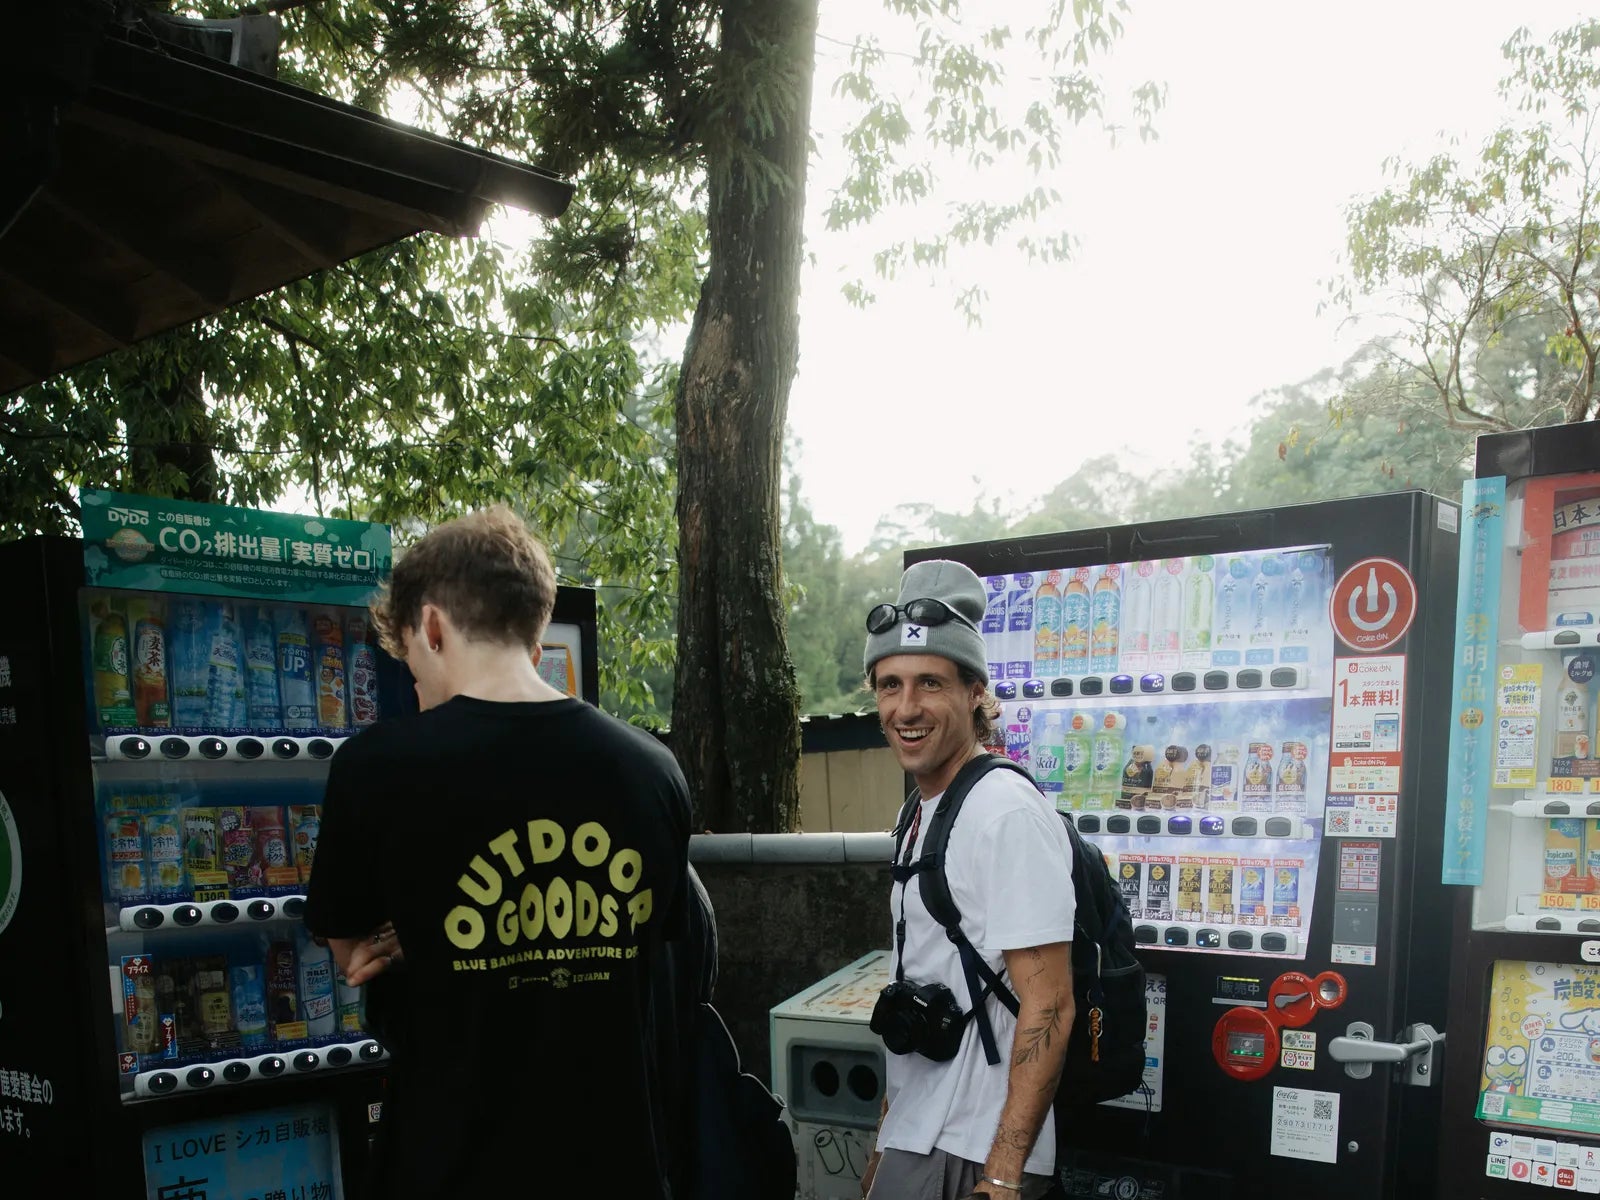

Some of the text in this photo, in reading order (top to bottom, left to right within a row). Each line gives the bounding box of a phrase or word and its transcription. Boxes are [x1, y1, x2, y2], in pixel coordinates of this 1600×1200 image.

[108, 507, 149, 526] DyDo
[157, 511, 211, 527] この自販機は
[1553, 503, 1600, 529] 日本
[1356, 635, 1376, 643] Coke
[148, 636, 161, 667] 麦茶
[1463, 613, 1489, 703] 発明品
[282, 656, 305, 672] UP
[1359, 665, 1379, 673] Coke
[1338, 678, 1400, 708] 1本無料!
[1547, 850, 1573, 859] Tropicana
[444, 818, 653, 950] OUTDOOR
[199, 891, 225, 901] 130円
[496, 876, 619, 946] GOODS
[452, 959, 487, 971] BLUE
[490, 949, 543, 969] BANANA
[546, 946, 622, 961] ADVENTURE
[1221, 981, 1260, 995] 販売中
[1277, 1119, 1334, 1132] 2907317712
[154, 1116, 329, 1163] I LOVE シカ自販機
